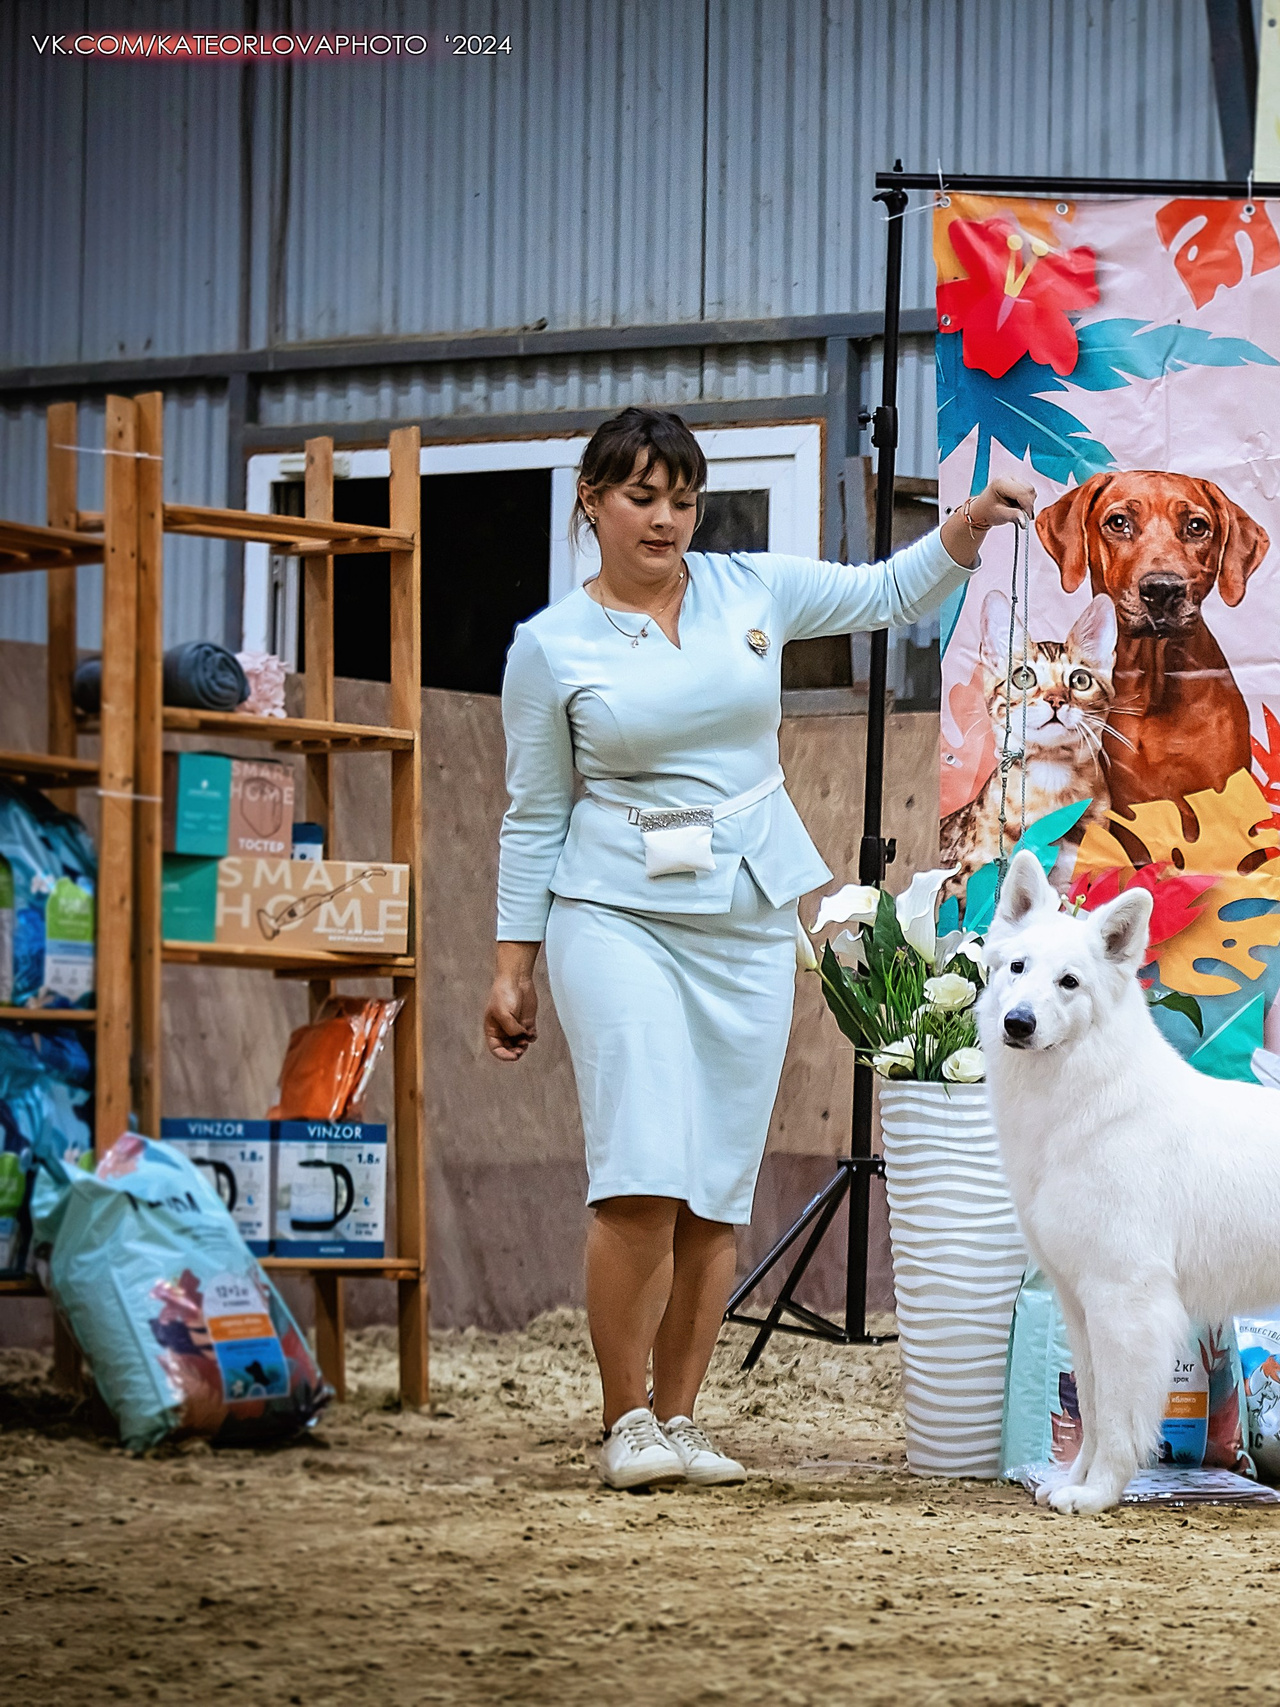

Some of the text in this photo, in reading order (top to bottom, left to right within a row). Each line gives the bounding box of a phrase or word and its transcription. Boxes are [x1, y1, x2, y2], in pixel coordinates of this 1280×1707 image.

[230, 781, 295, 805] HOME
[238, 837, 285, 853] ТОСТЕР
[217, 856, 410, 895] SMART
[215, 892, 408, 936] HOME
[188, 1123, 245, 1136] VINZOR
[307, 1126, 362, 1139] VINZOR
[1182, 1363, 1195, 1372] кг
